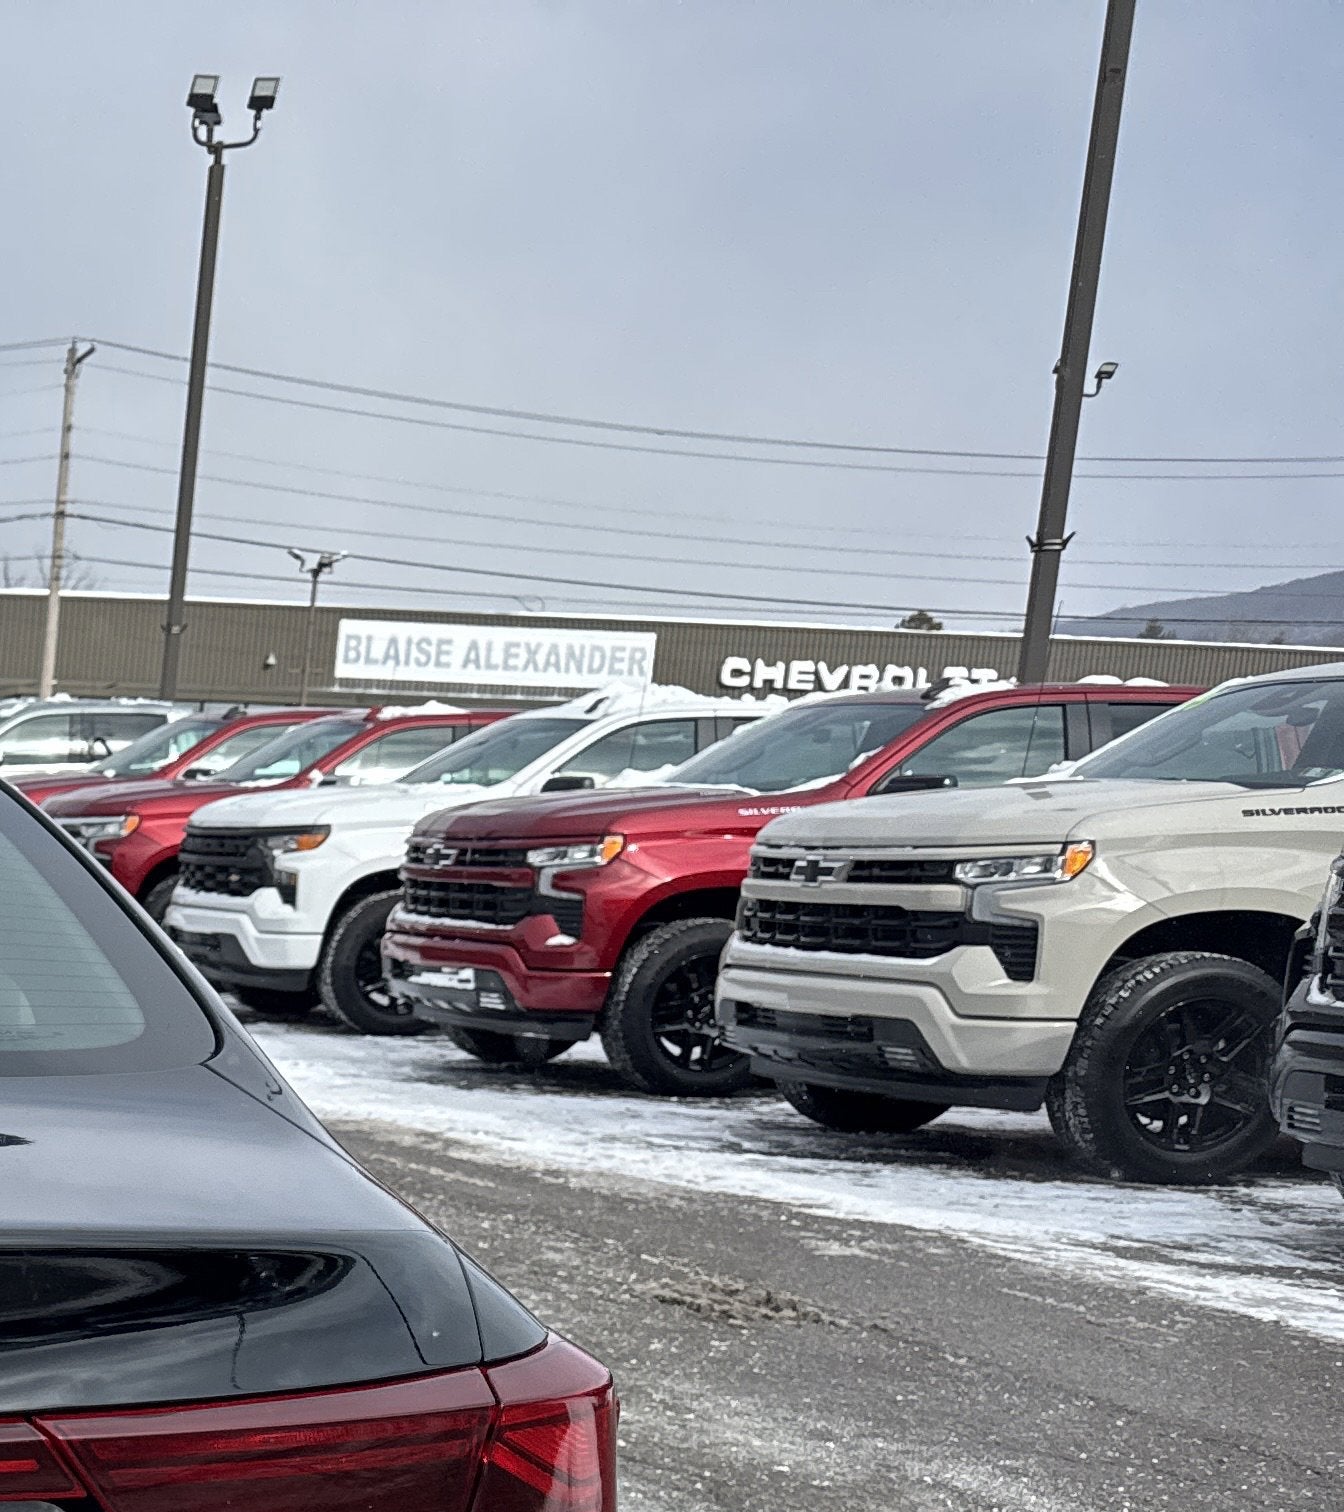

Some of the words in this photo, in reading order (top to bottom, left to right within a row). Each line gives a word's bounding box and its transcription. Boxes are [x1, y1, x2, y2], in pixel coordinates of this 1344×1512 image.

[342, 633, 454, 669] BLAISE
[461, 639, 649, 678] ALEXANDER
[737, 806, 800, 816] SILVER
